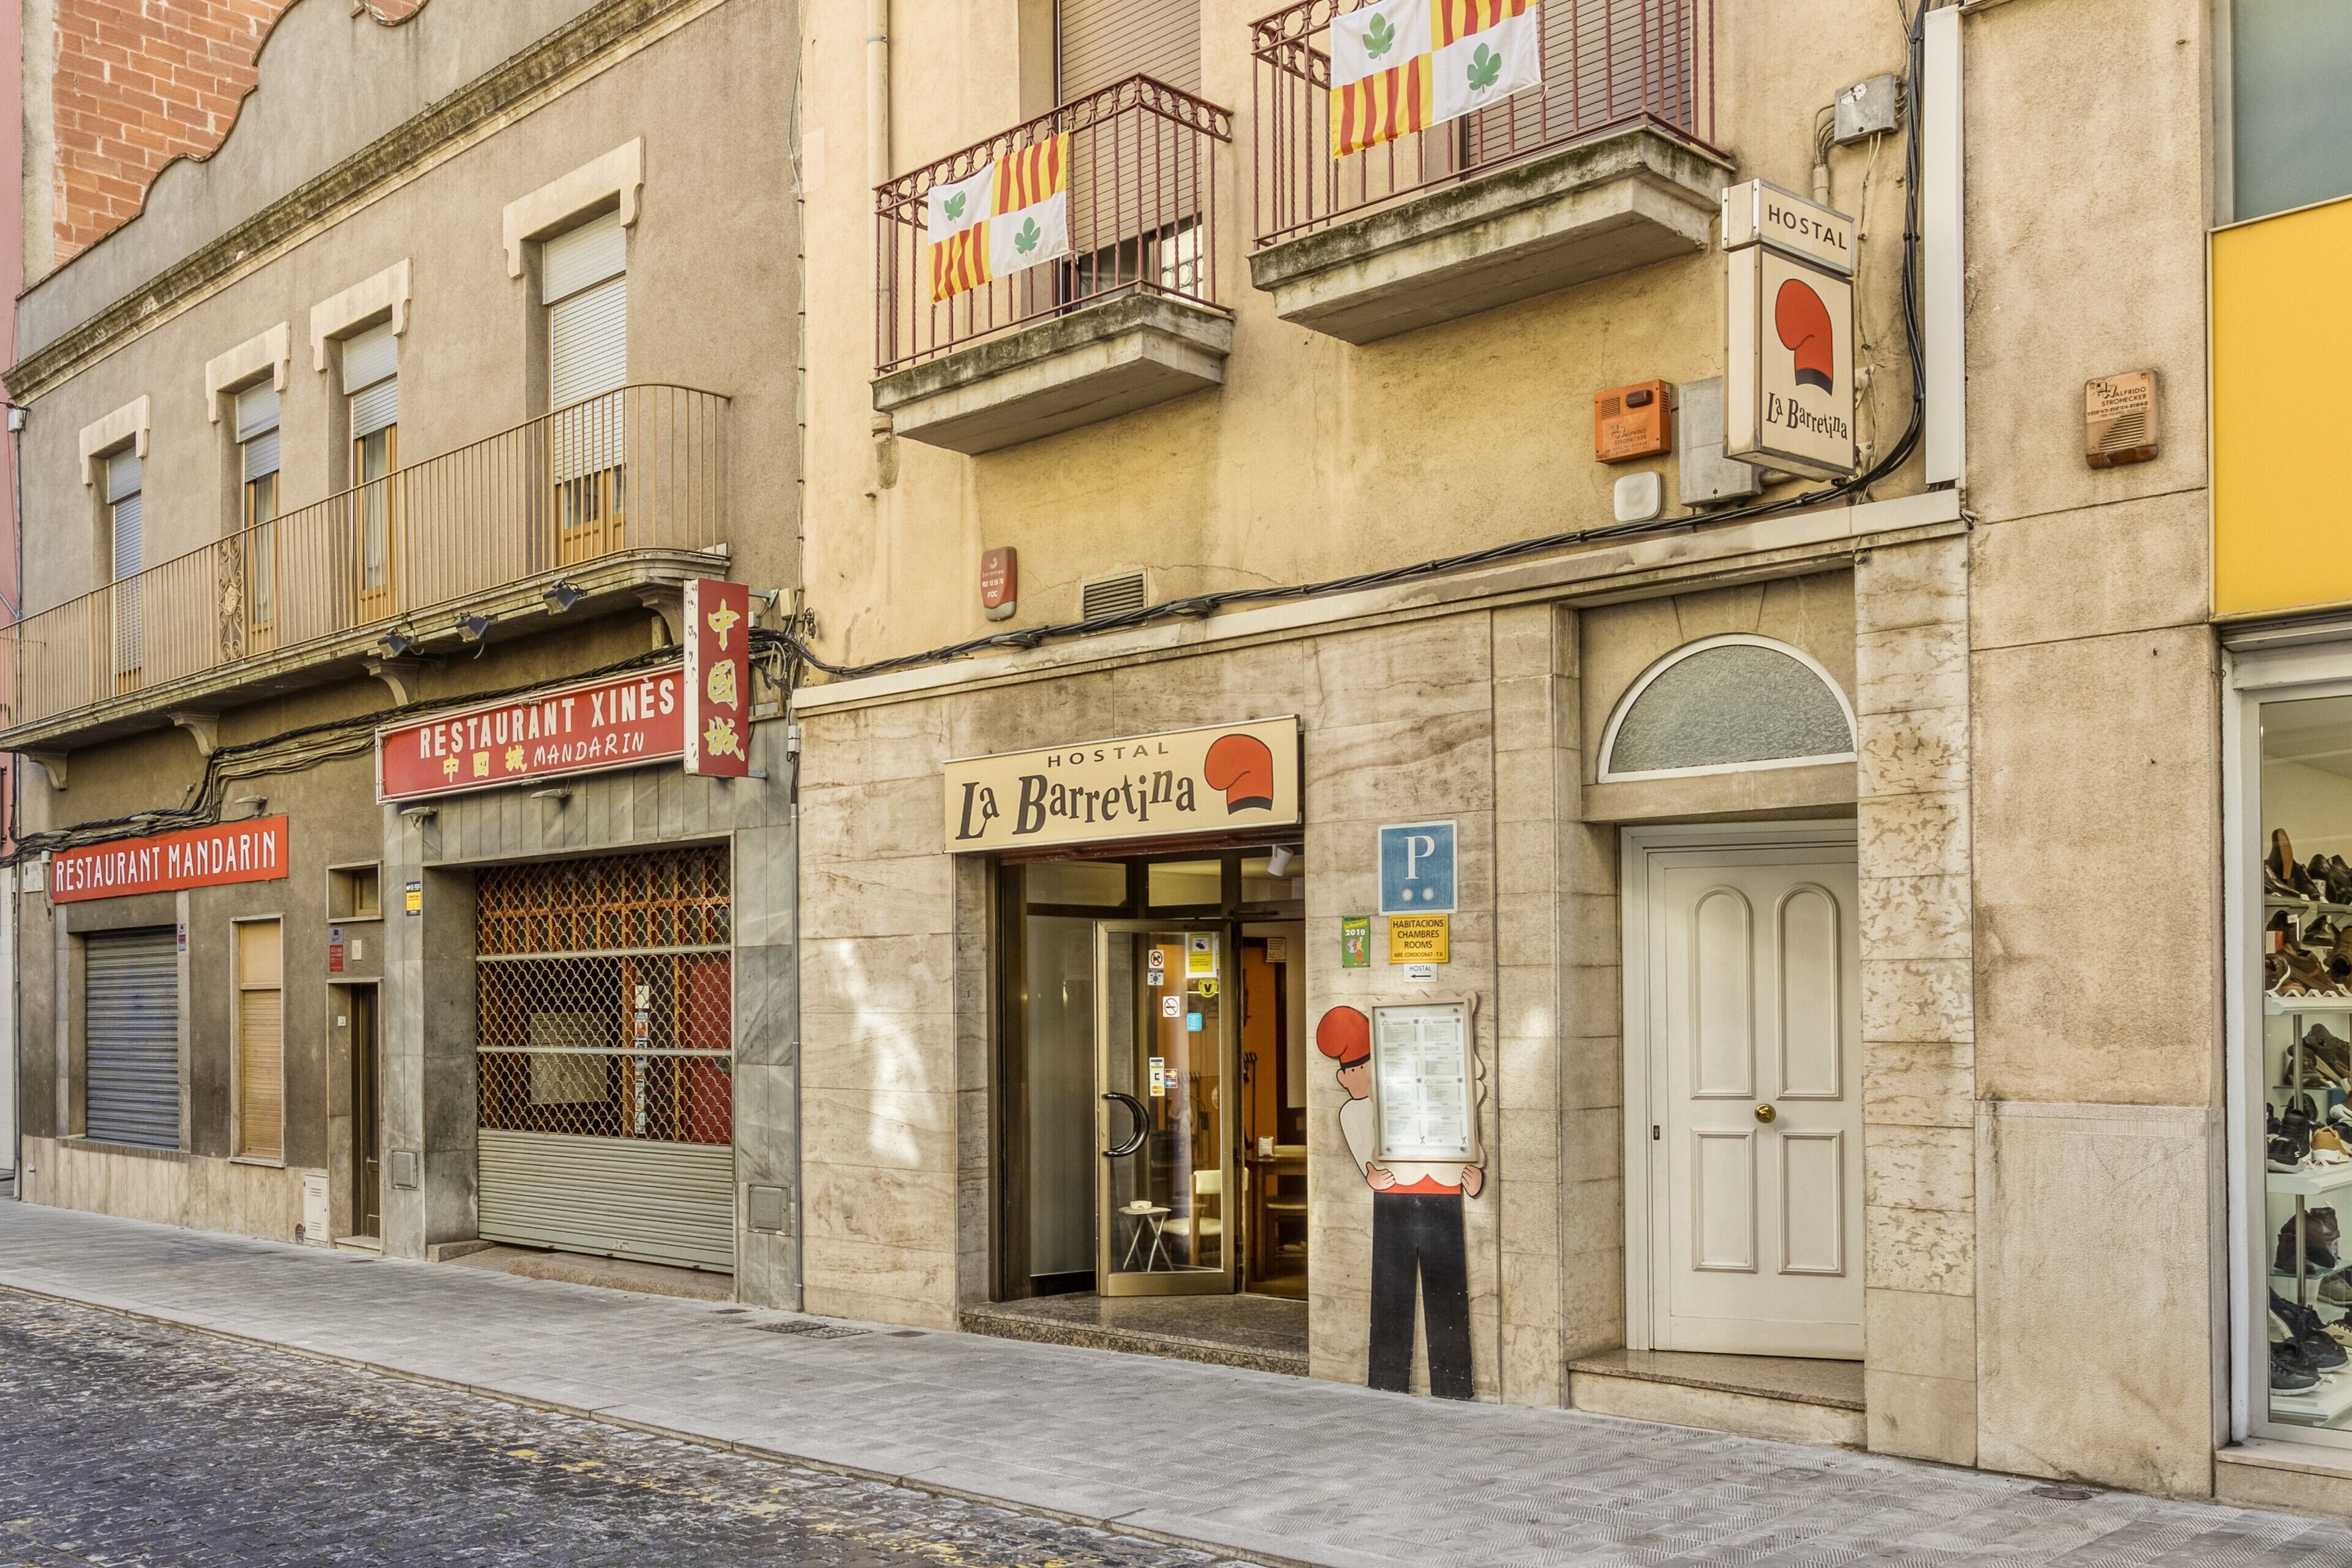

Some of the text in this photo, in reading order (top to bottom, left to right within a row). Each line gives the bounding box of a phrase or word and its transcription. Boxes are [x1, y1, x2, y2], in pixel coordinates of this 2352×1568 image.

[1768, 204, 1847, 251] HOSTAL
[1766, 392, 1847, 440] La Barretina
[2101, 394, 2146, 407] STROHECKER
[987, 590, 998, 598] FOC
[420, 677, 674, 759] RESTAURANT XINÈS
[533, 731, 644, 767] MANDARIN
[1048, 742, 1169, 768] HOSTAL
[955, 769, 1197, 840] La Barretina
[56, 831, 276, 892] RESTAURANT MANDARIN
[1404, 835, 1435, 880] P
[1393, 919, 1444, 929] HABITACIONS
[1398, 930, 1439, 938] CHAMBRES
